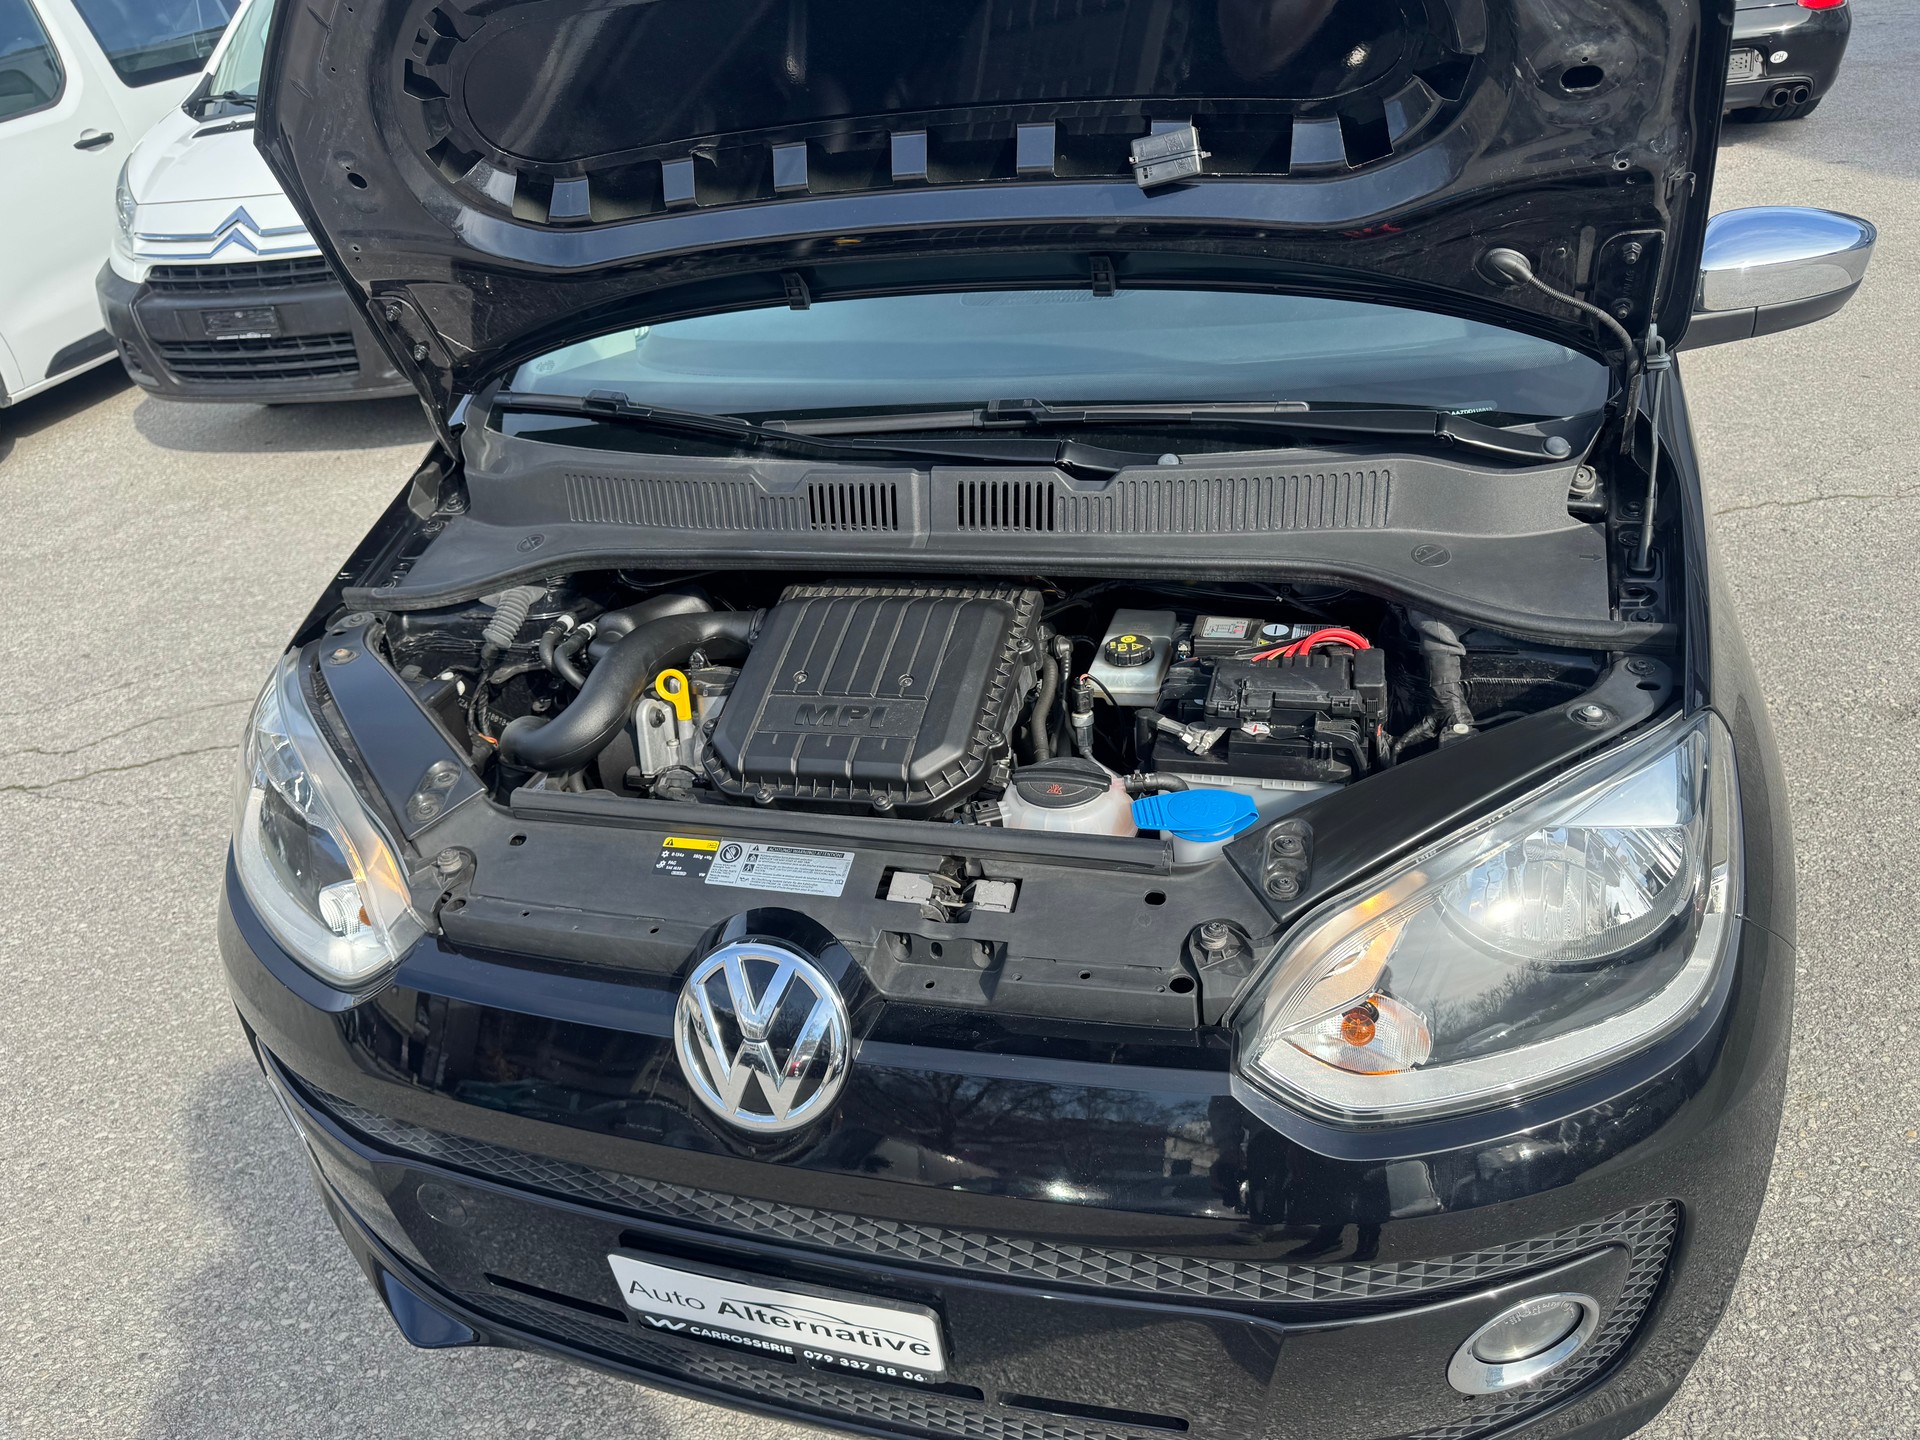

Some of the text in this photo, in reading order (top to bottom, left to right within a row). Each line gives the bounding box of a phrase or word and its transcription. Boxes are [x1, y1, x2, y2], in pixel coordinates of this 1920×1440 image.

[1773, 53, 1785, 61] CH
[794, 703, 889, 729] MPI
[629, 1280, 932, 1356] Auto Alternative
[689, 1326, 794, 1355] CARROSSERIE
[803, 1349, 834, 1363] 079
[839, 1357, 870, 1370] 337
[876, 1364, 898, 1377] 88
[902, 1370, 925, 1382] 06
